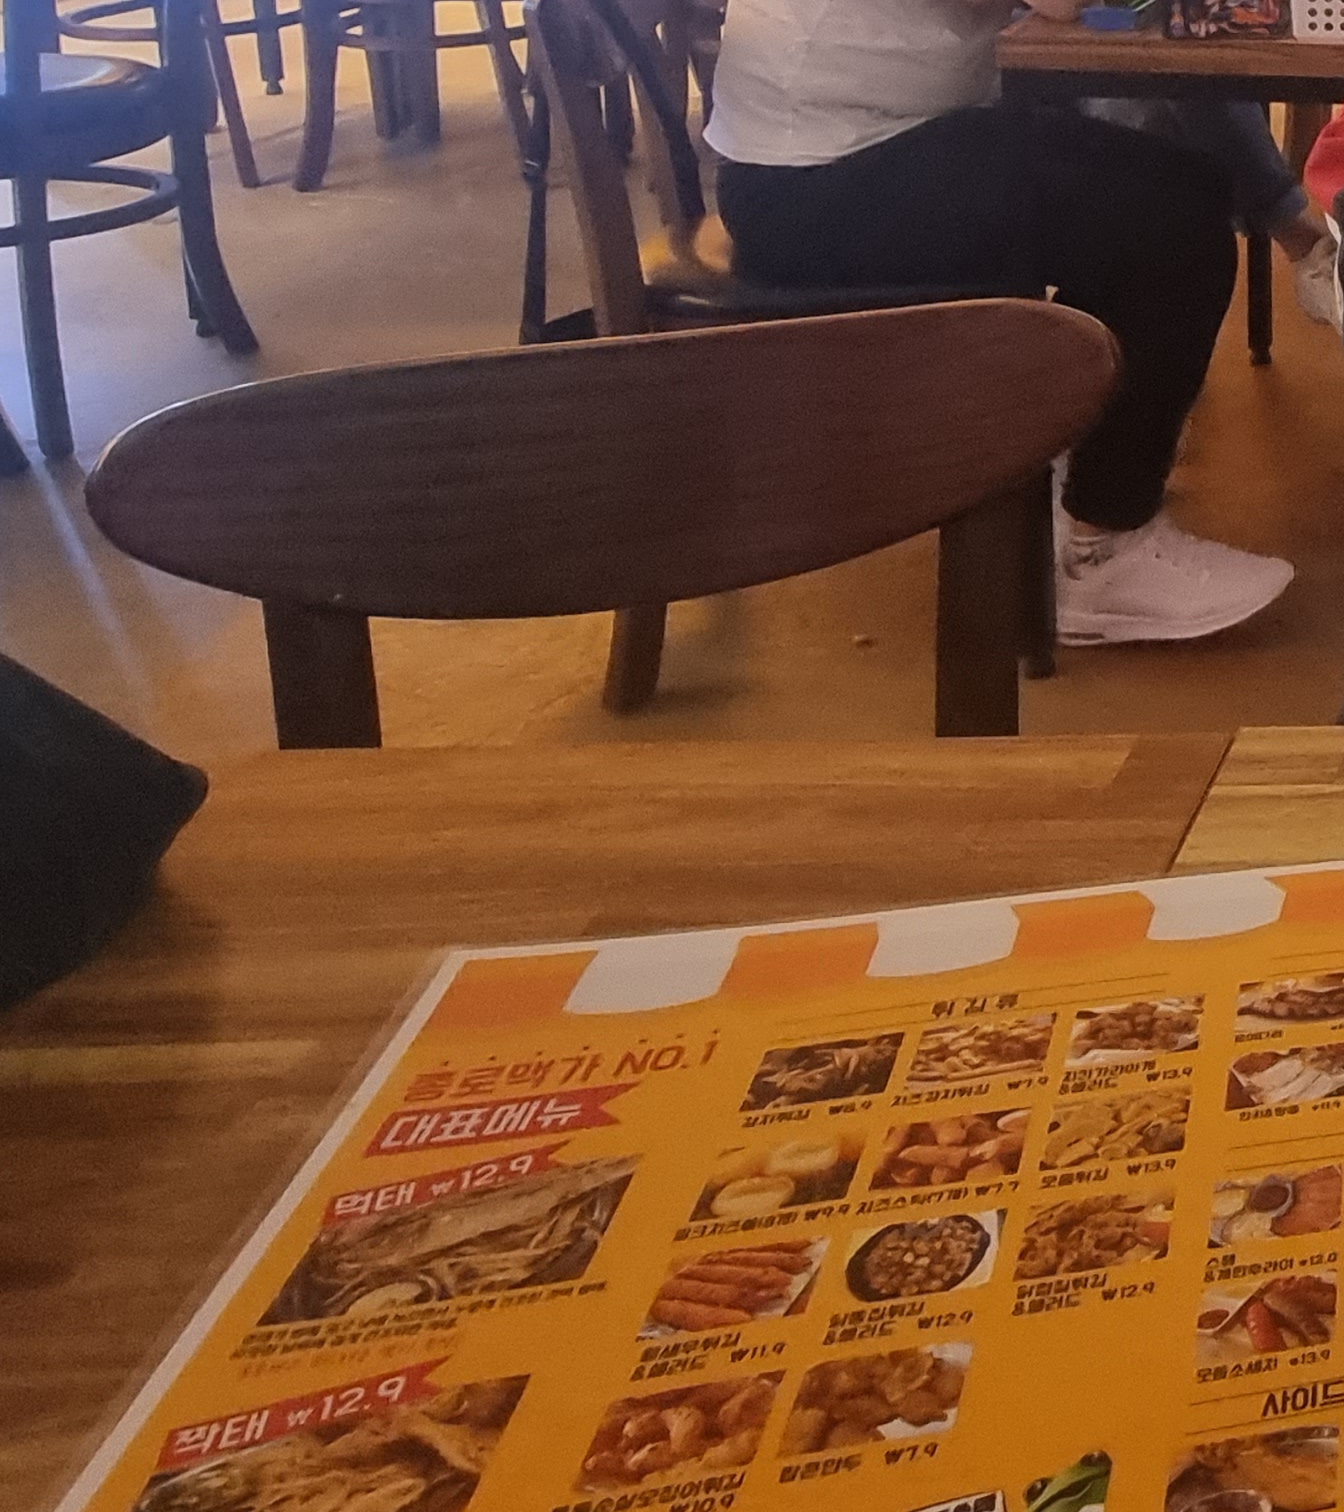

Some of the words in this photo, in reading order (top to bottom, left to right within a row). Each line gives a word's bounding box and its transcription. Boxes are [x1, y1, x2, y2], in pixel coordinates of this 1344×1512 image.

[379, 1097, 582, 1150] 대표메뉴
[334, 1181, 416, 1218] 먹태
[173, 1409, 270, 1454] 짝태
